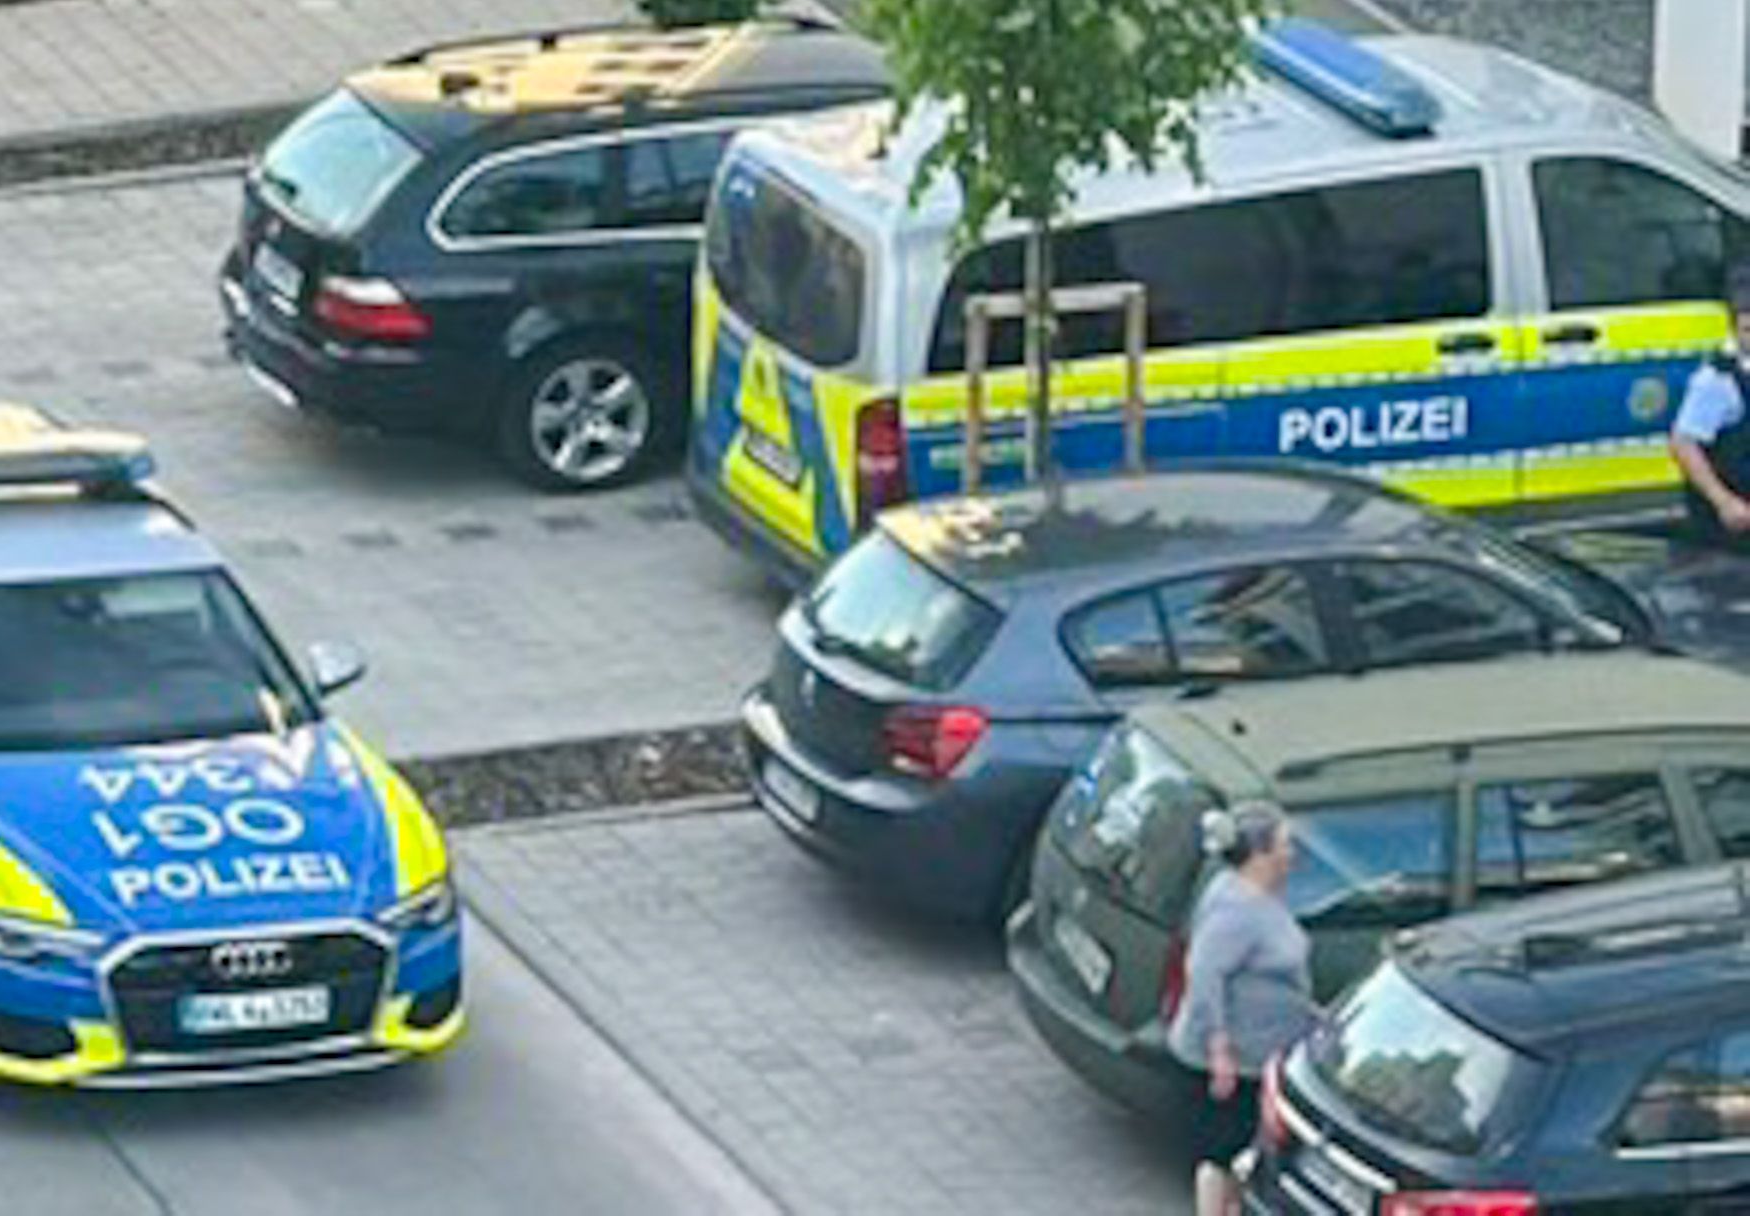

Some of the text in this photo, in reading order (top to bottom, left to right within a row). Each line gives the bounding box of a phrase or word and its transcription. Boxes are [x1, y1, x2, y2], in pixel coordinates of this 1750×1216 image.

[1278, 395, 1469, 453] POLIZEI
[89, 798, 306, 858] OG1
[109, 851, 352, 908] POLIZEI
